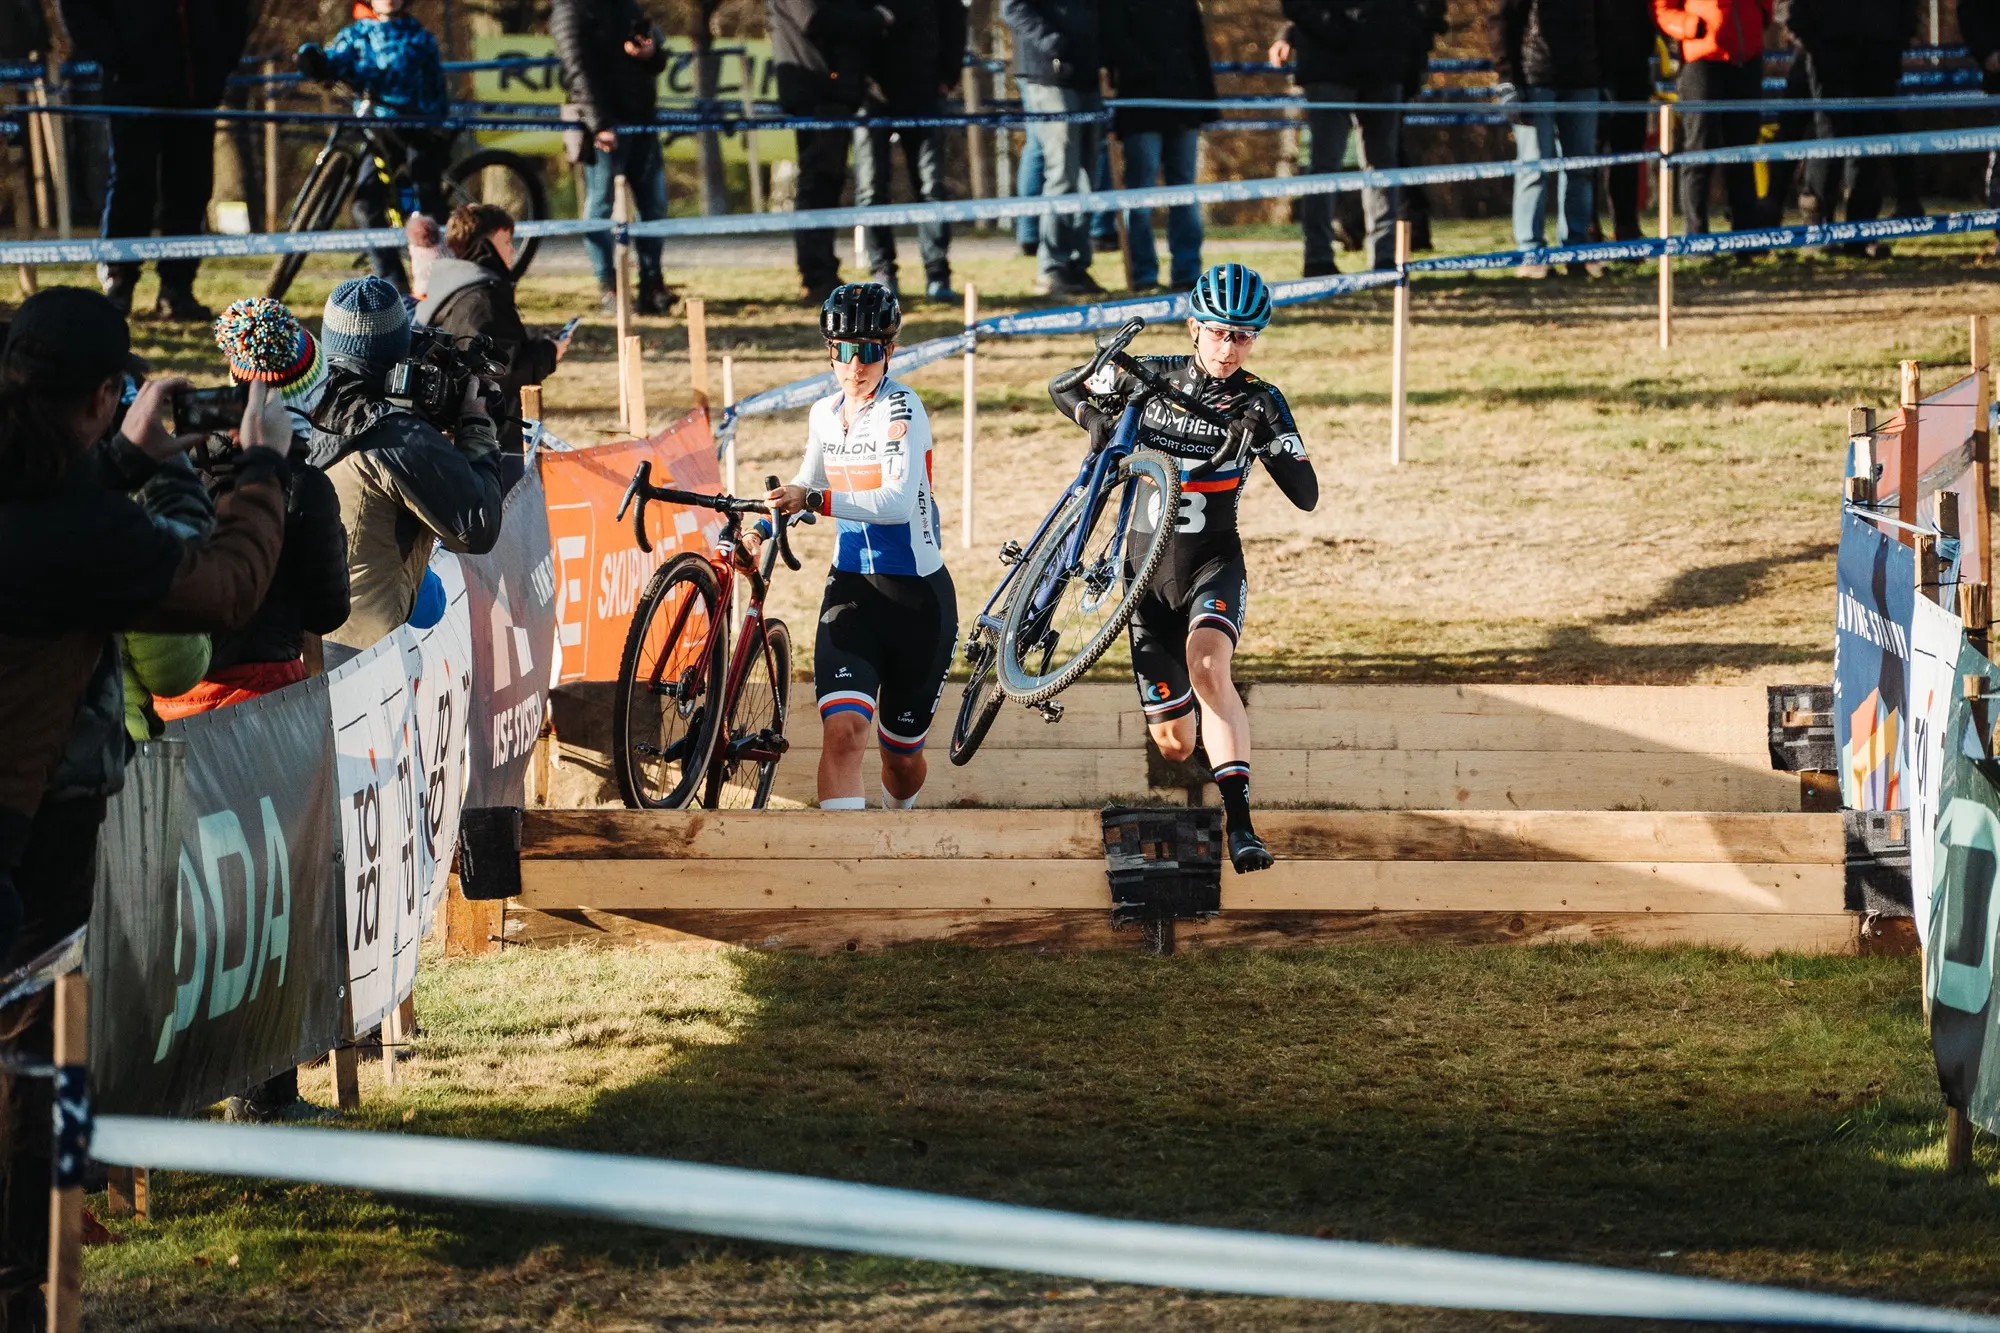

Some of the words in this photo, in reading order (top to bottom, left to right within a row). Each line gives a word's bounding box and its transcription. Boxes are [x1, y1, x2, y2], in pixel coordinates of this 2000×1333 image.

[1180, 443, 1216, 455] SOCKS
[493, 706, 514, 769] HSF
[353, 781, 381, 868] TOI
[353, 863, 381, 951] TOI
